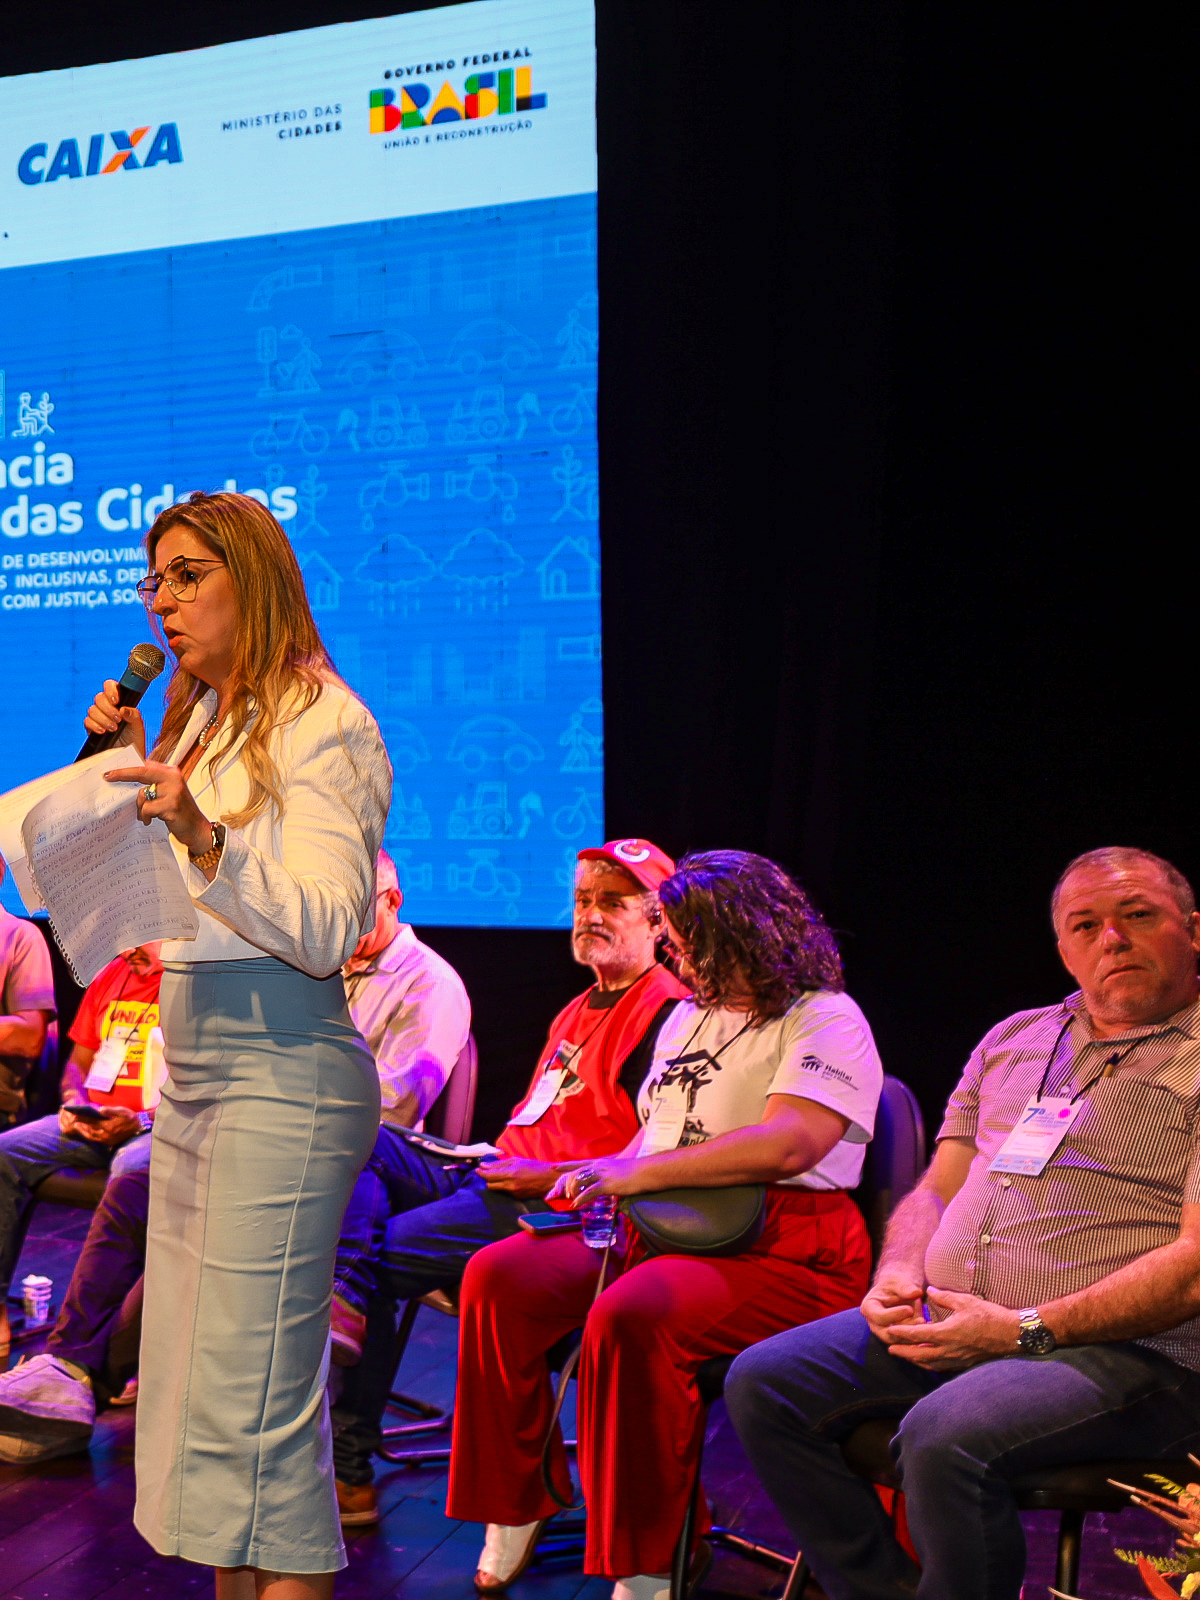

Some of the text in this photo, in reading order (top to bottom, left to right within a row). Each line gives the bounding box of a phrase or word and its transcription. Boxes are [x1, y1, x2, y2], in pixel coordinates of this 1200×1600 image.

[384, 47, 533, 79] GOVERNO FEDERAL
[369, 65, 547, 135] BRASIL
[314, 103, 342, 117] DAS
[278, 120, 343, 139] CIDADES
[384, 136, 420, 149] UNIÃO
[17, 122, 183, 186] CAIXA
[0, 494, 85, 538] das
[3, 554, 24, 569] DE
[15, 569, 112, 588] INCLUSIVAS,
[3, 594, 40, 610] COM
[44, 591, 108, 609] JUSTIÇA
